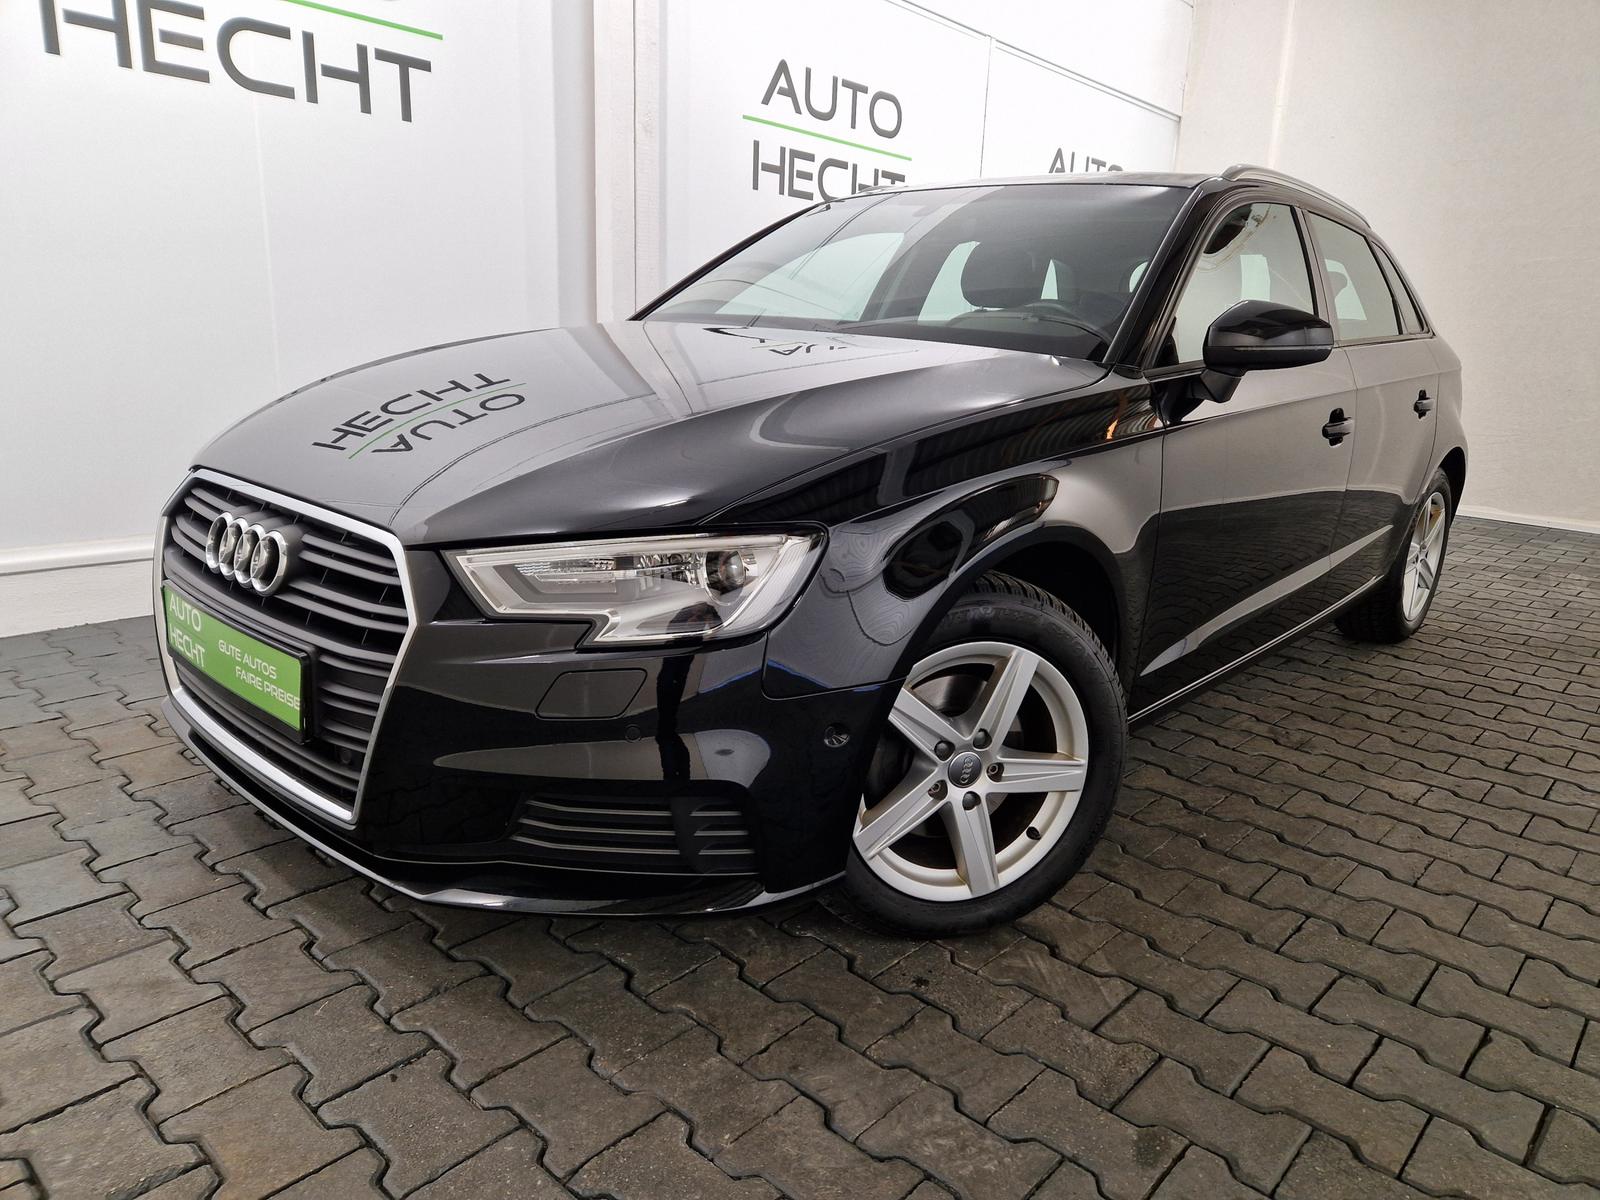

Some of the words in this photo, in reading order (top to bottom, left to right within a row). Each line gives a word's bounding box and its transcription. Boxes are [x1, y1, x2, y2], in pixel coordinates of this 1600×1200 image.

[39, 0, 432, 123] HECHT
[761, 58, 903, 139] AUTO
[1048, 147, 1124, 174] AUT
[170, 593, 202, 632] AUTO
[170, 623, 205, 668] HECHT
[218, 639, 242, 661] GUTE
[242, 653, 277, 680] AUTOS
[235, 666, 263, 691] FAIRE
[263, 681, 300, 711] PREISE
